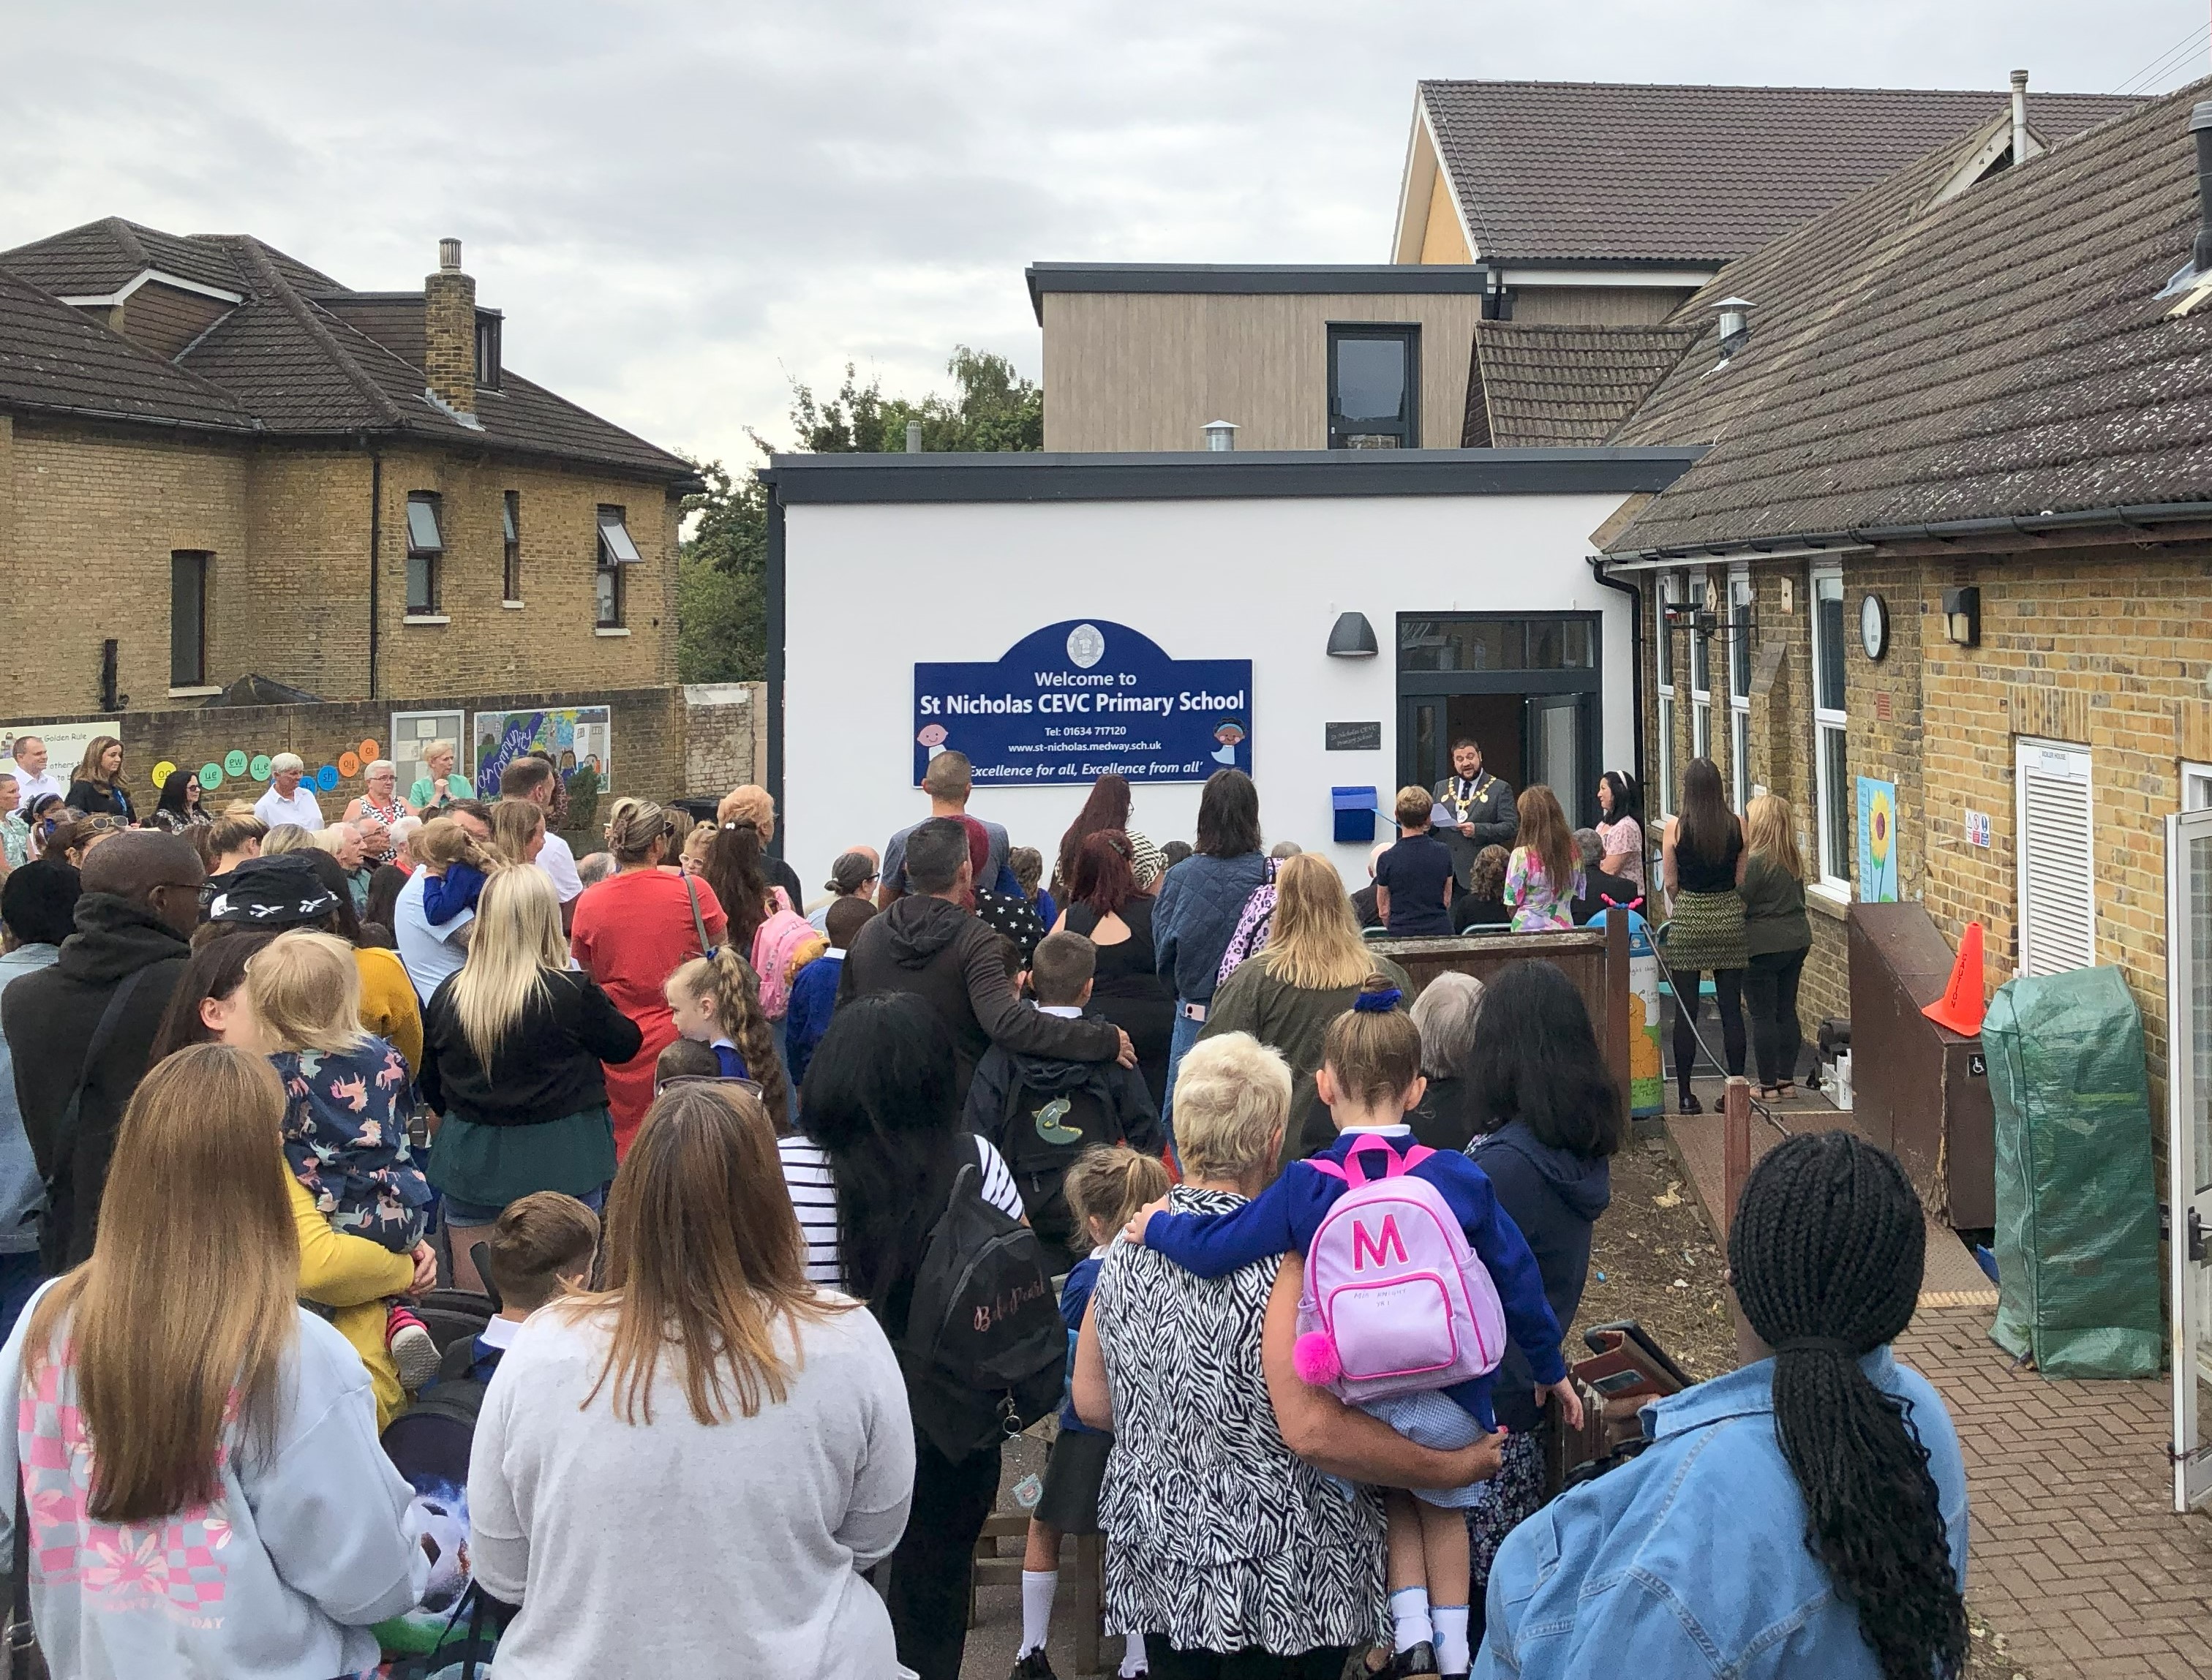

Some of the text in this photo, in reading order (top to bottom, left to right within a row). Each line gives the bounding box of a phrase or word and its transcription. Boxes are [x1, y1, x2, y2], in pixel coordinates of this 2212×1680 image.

[1034, 671, 1137, 687] Welcome to
[920, 690, 1244, 717] St Nicholas CEVC Primary School
[44, 734, 69, 742] Golden
[1045, 726, 1126, 737] Tel: 01634 717120
[1007, 740, 1162, 753] www.st-nicholas.medway.sch.uk
[229, 758, 243, 766] ew
[205, 771, 217, 780] ue
[323, 772, 333, 780] sh
[1035, 764, 1056, 778] for
[1058, 763, 1077, 777] all,
[1081, 762, 1146, 776] Excellence
[1148, 761, 1180, 776] from
[1951, 953, 1968, 1009] CAUTION
[1353, 1213, 1409, 1272] M
[191, 1617, 225, 1630] DAY
